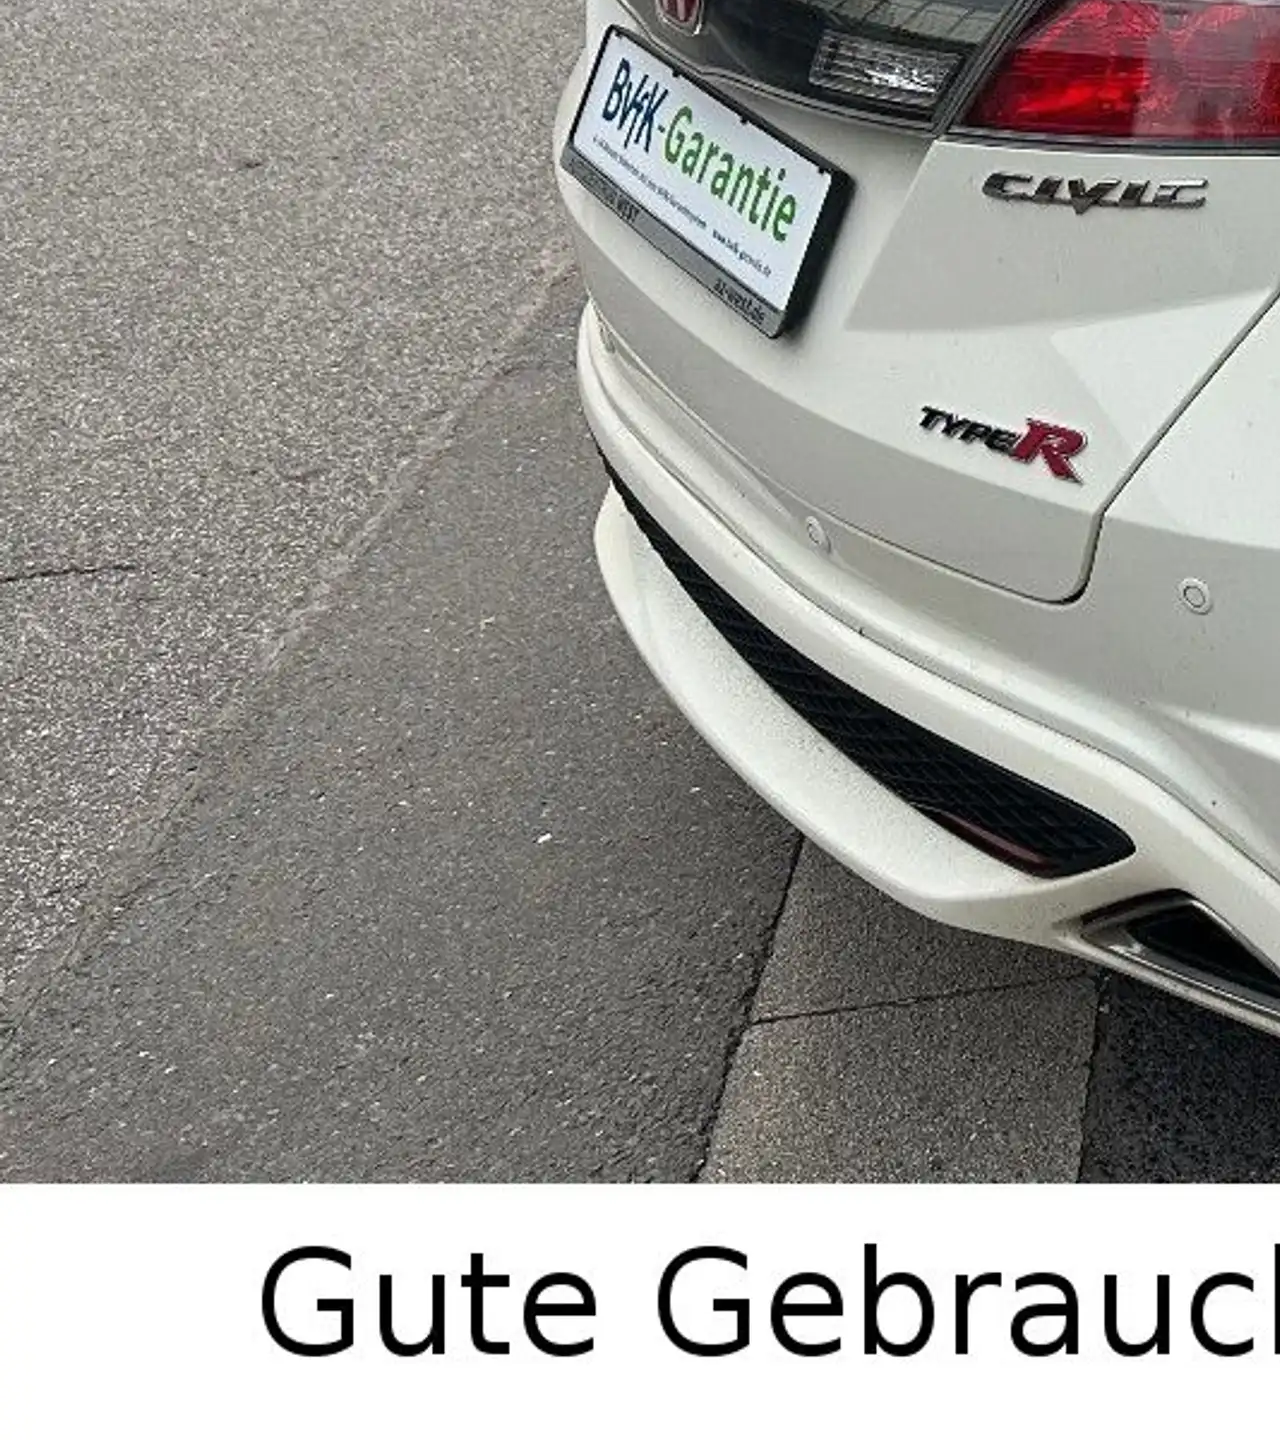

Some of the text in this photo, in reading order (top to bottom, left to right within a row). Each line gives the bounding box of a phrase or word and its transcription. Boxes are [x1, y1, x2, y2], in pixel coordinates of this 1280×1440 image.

[981, 171, 1209, 216] CIVIC
[918, 406, 1089, 486] TYPE R
